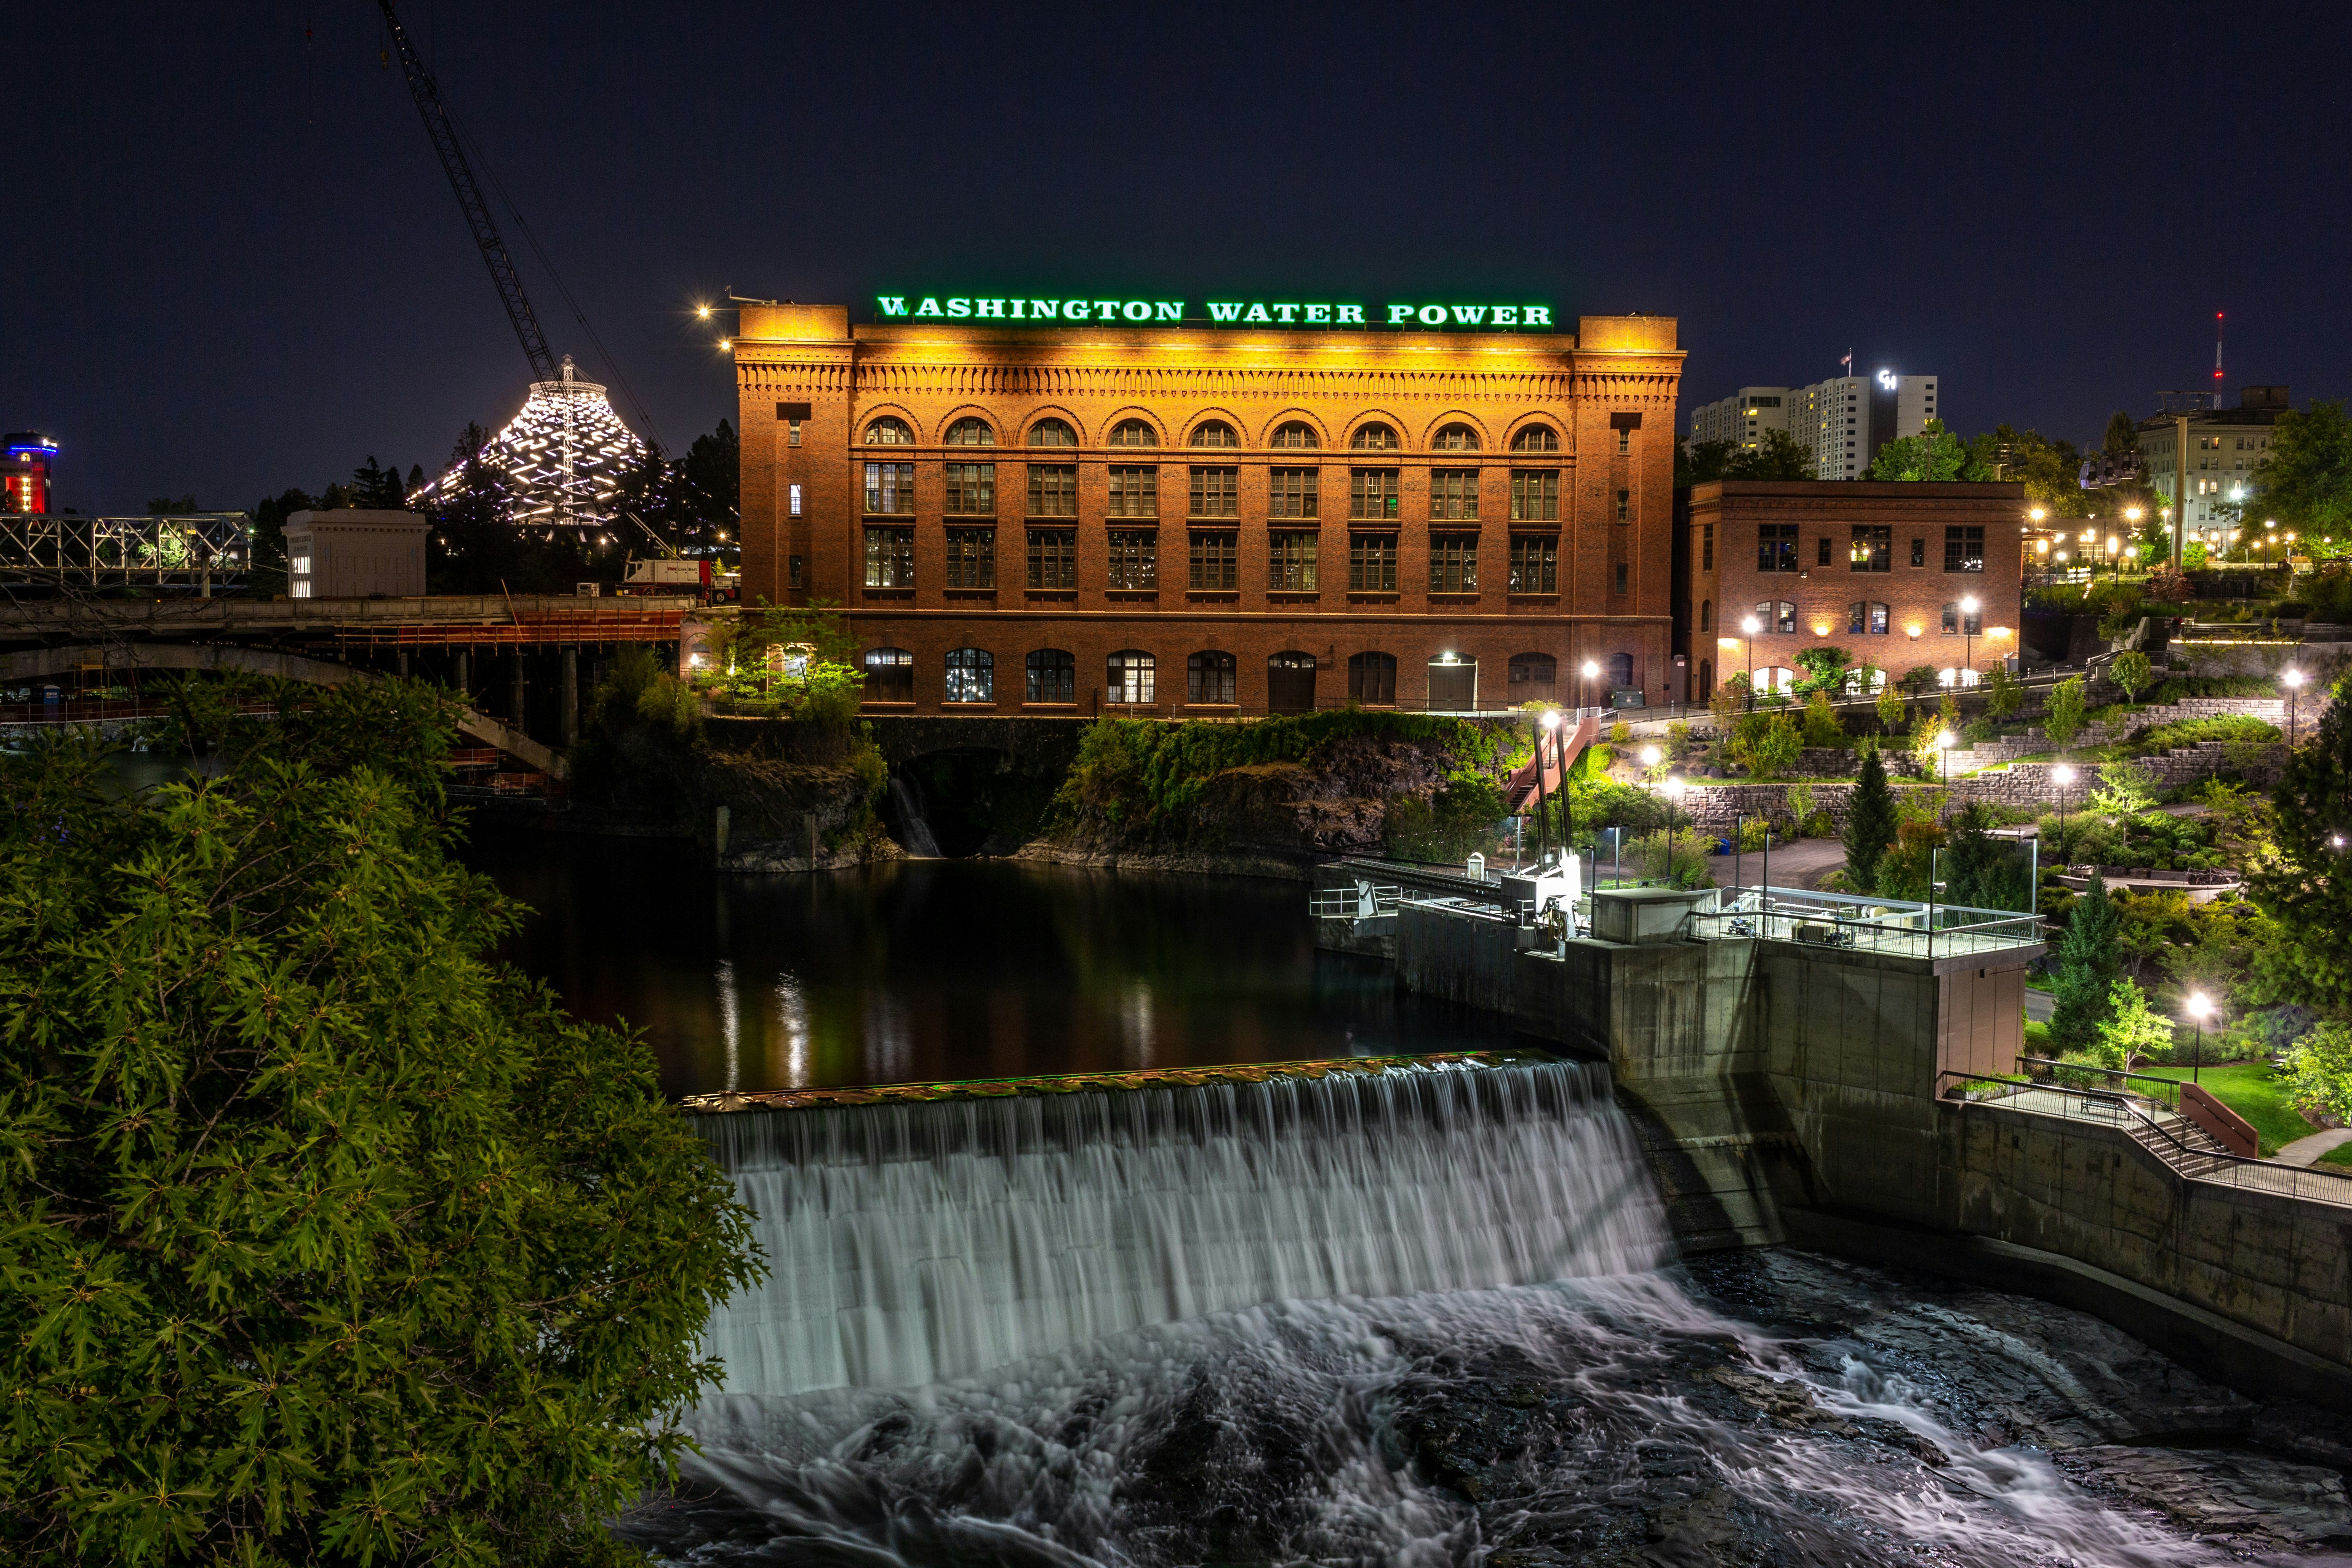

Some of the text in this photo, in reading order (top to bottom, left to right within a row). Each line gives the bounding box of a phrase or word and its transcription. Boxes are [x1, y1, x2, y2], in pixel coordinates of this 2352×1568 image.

[877, 297, 1552, 325] WASHINGTON WATER POWER
